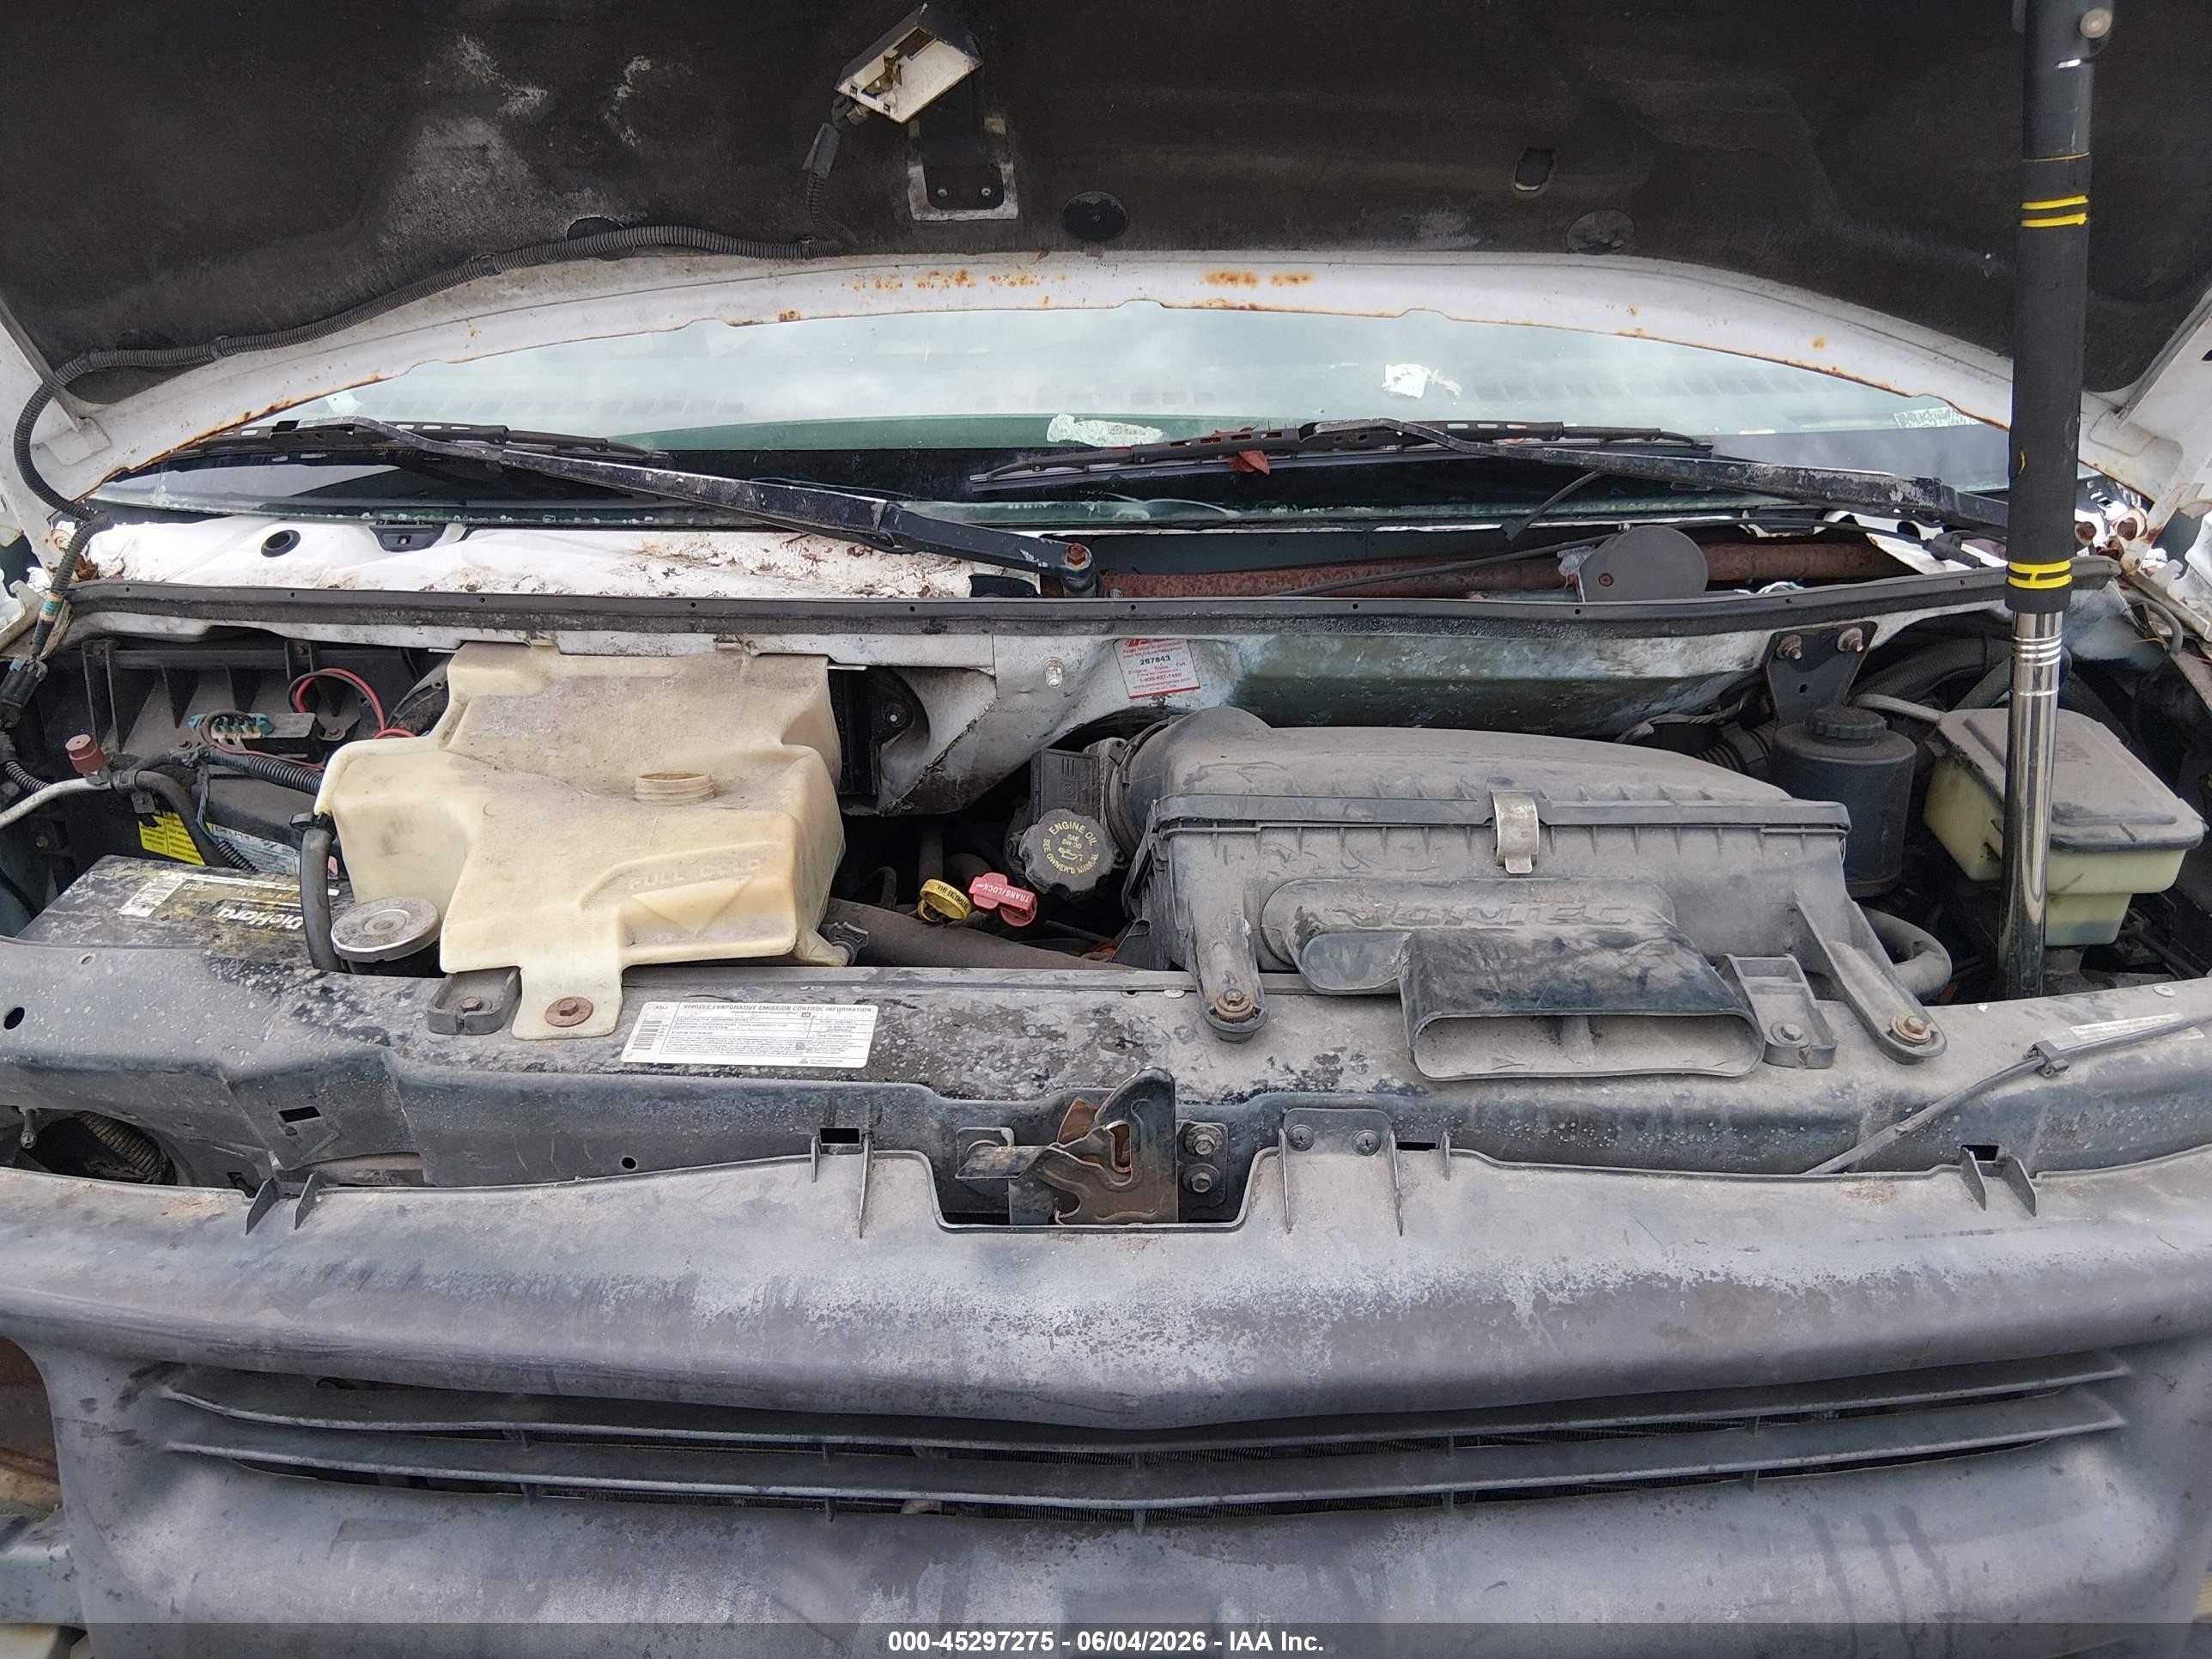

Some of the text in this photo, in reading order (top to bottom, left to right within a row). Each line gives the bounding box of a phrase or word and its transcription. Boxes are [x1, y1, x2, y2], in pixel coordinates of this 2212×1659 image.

[1139, 654, 1171, 665] 267843
[1048, 821, 1097, 847] ENGINE OIL
[1042, 838, 1099, 874] SEE OWNER'S MANUAL
[982, 883, 1030, 902] TRANS/LOCK
[215, 907, 304, 930] DieHard
